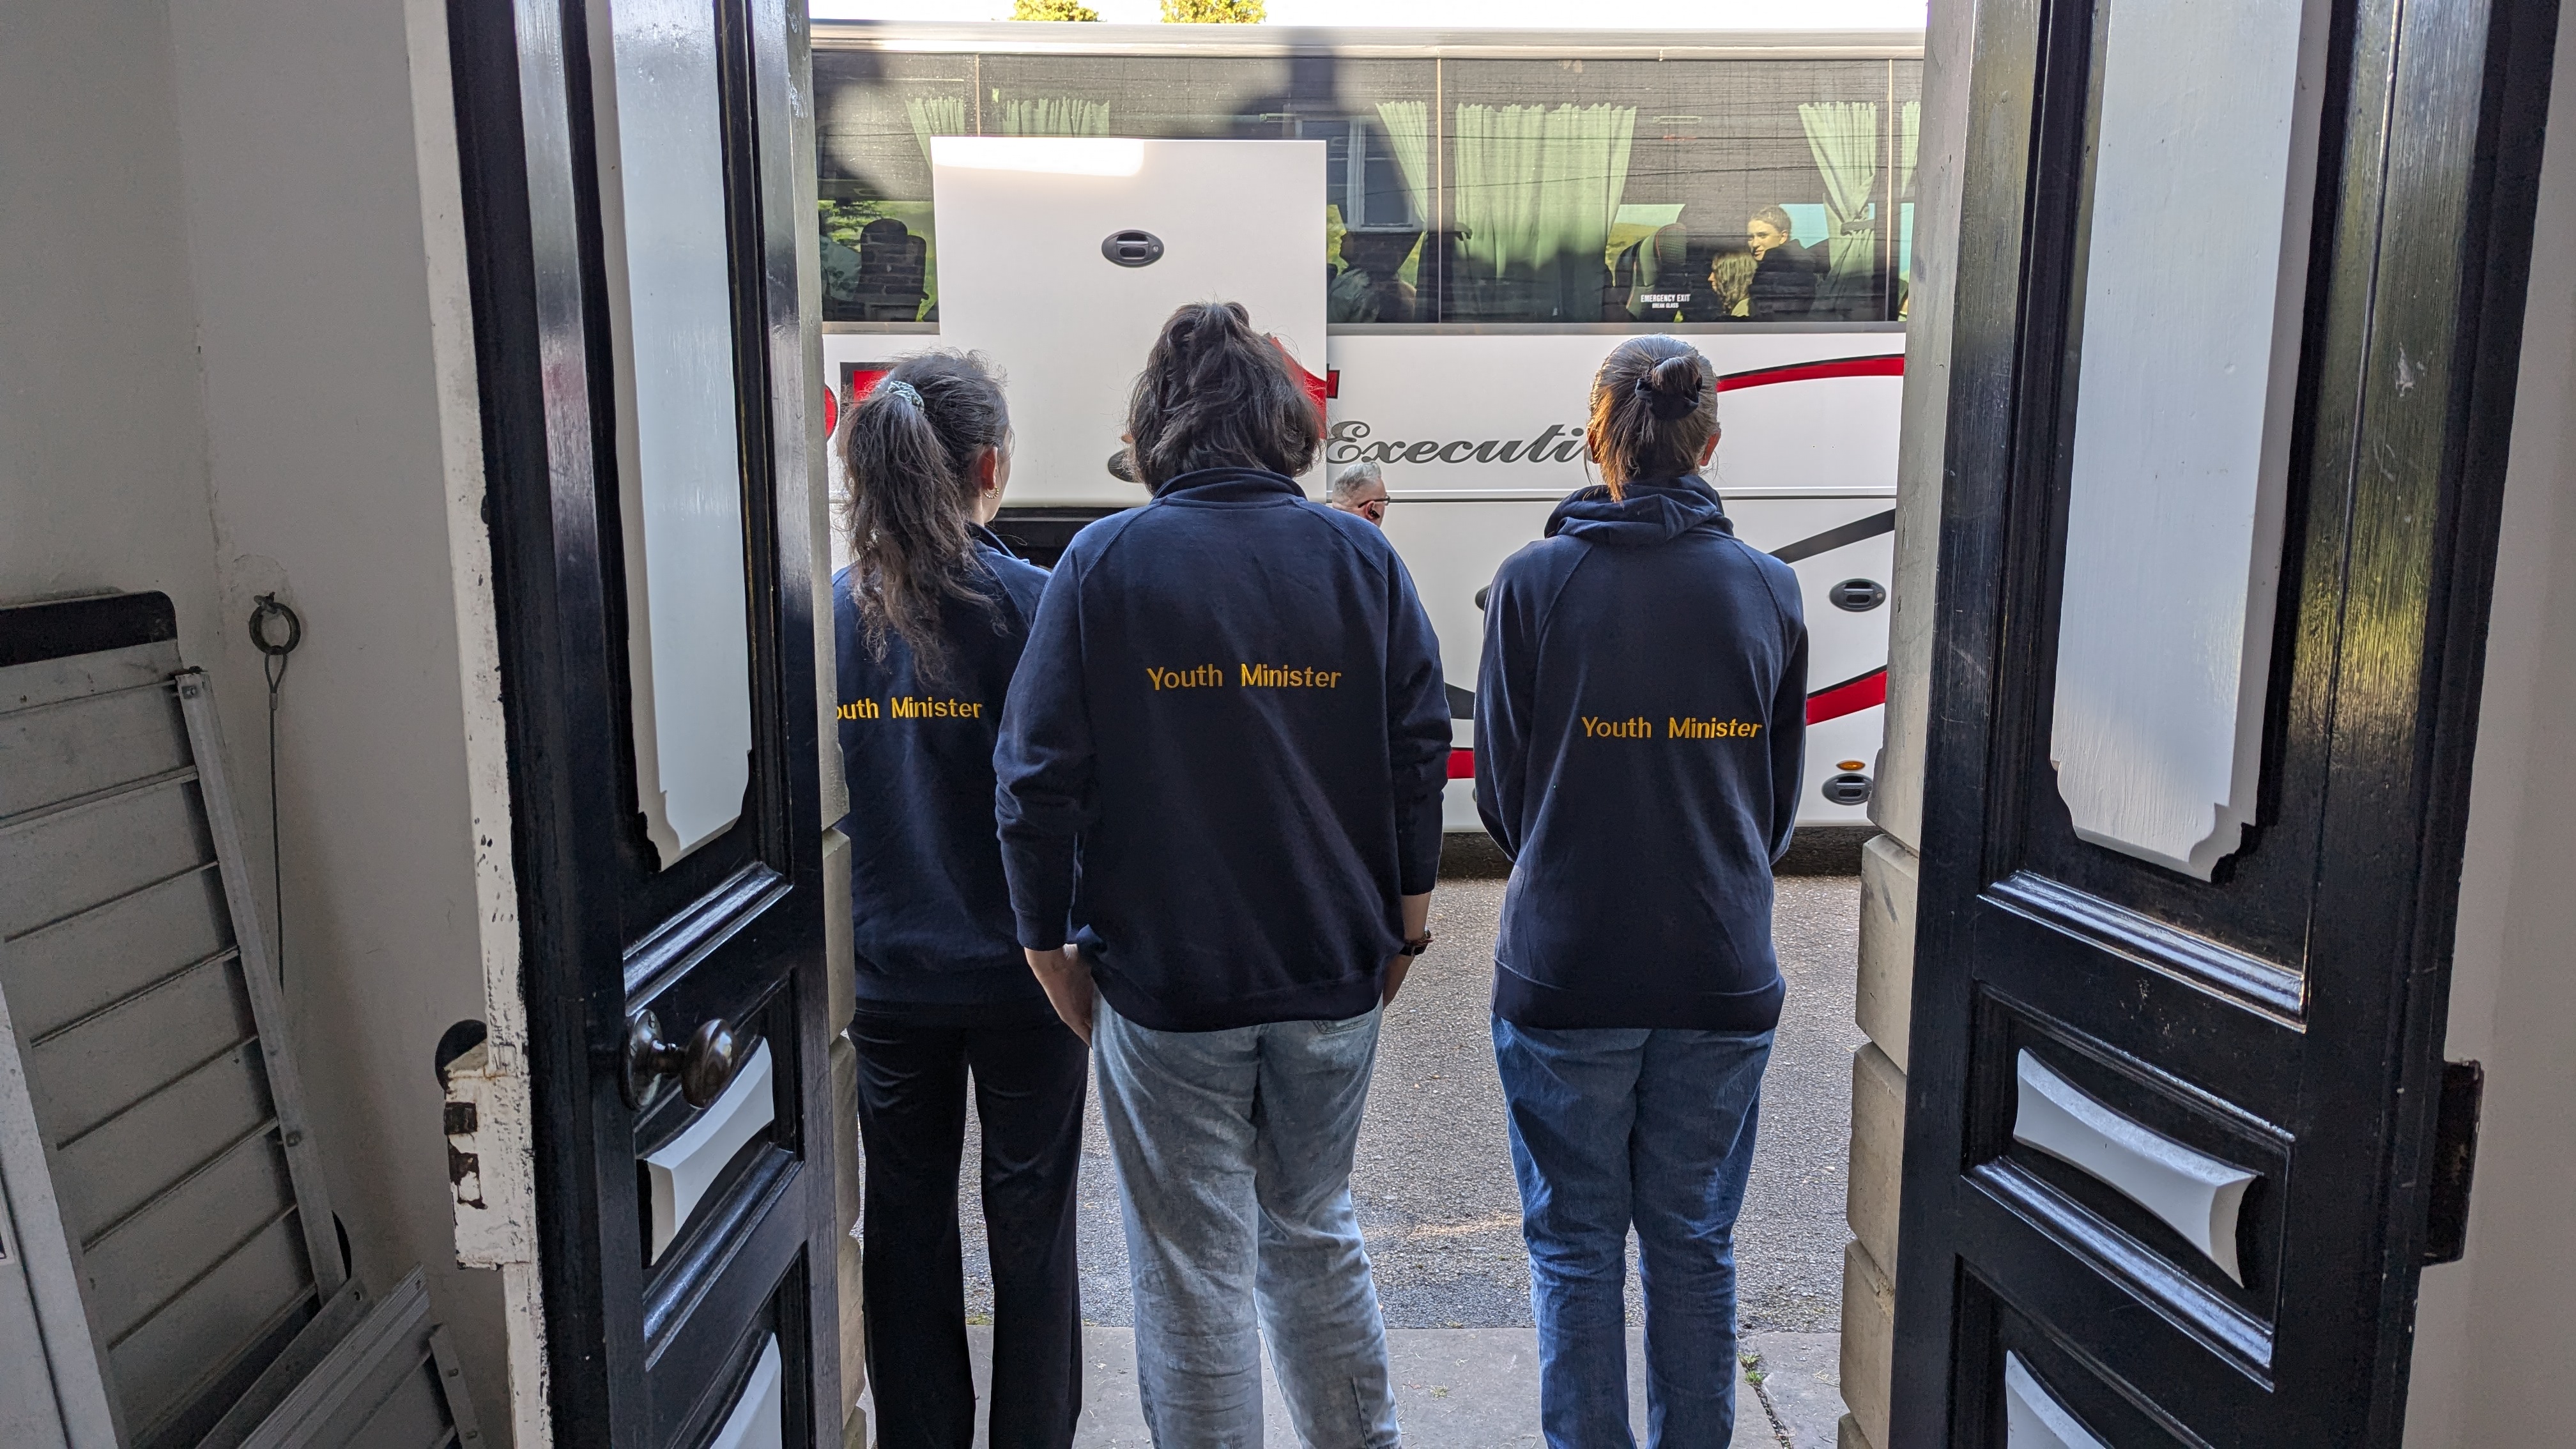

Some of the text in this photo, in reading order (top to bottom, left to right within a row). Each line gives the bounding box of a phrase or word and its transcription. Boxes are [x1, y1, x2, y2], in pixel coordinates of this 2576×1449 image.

[1326, 420, 1586, 464] Executi
[1147, 663, 1341, 690] Youth Minister
[891, 696, 982, 719] Minister
[1581, 716, 1763, 739] Youth Minister
